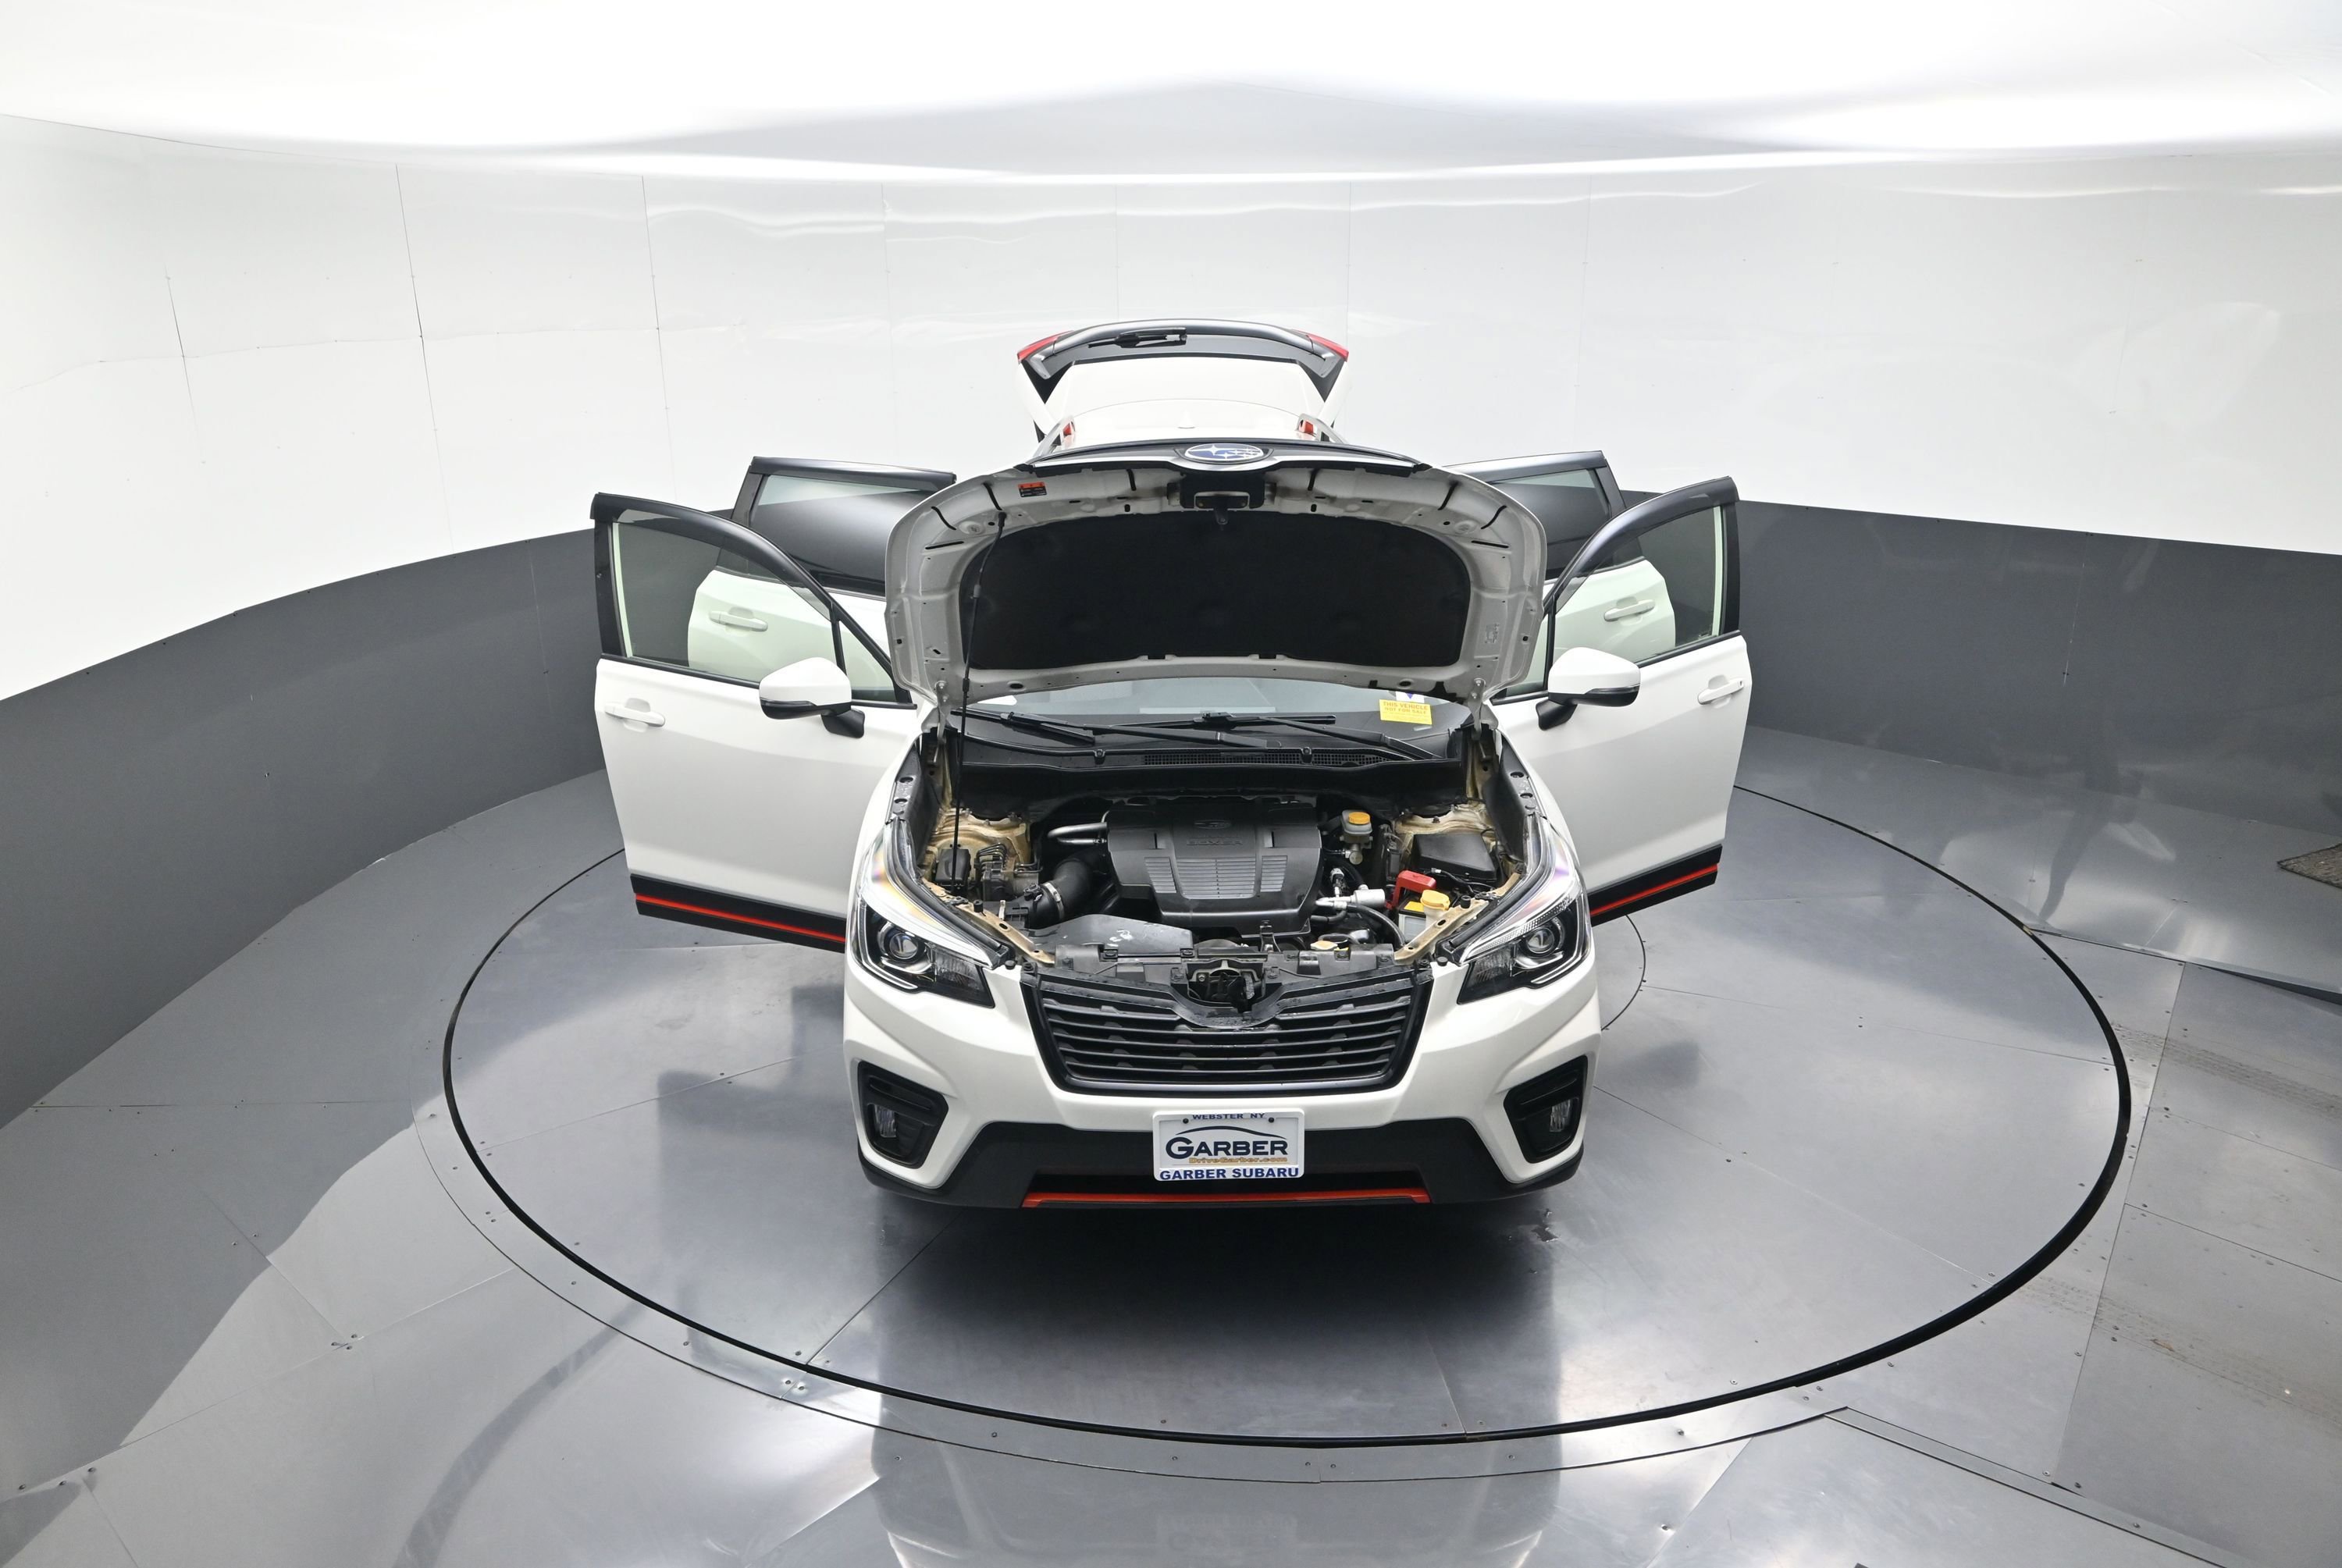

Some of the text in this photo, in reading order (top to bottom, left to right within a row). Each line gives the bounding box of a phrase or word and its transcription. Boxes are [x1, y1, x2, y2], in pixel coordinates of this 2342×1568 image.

[1166, 1136, 1288, 1160] GARBER
[1159, 1168, 1299, 1180] GARBER SUBARU
